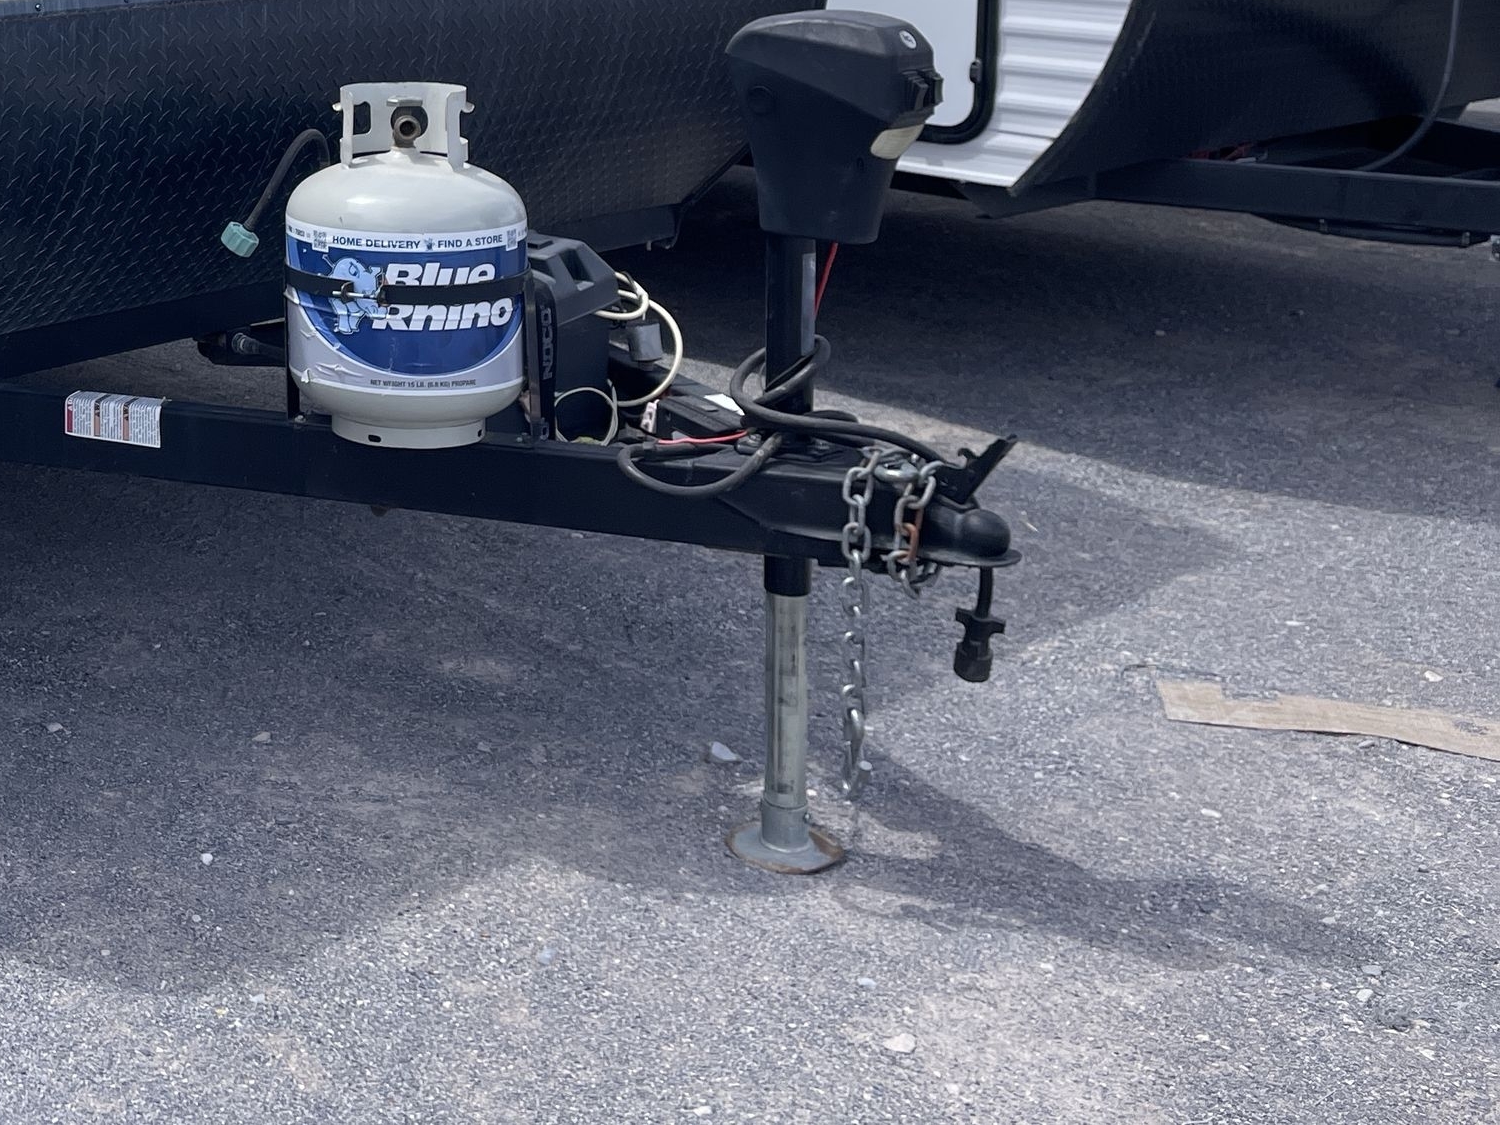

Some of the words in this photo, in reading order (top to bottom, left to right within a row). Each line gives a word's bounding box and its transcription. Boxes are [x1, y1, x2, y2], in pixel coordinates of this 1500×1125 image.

[332, 235, 363, 247] HOME
[365, 238, 421, 249] DELIVERY
[437, 238, 463, 249] FIND
[465, 237, 473, 247] A
[475, 234, 503, 246] STORE
